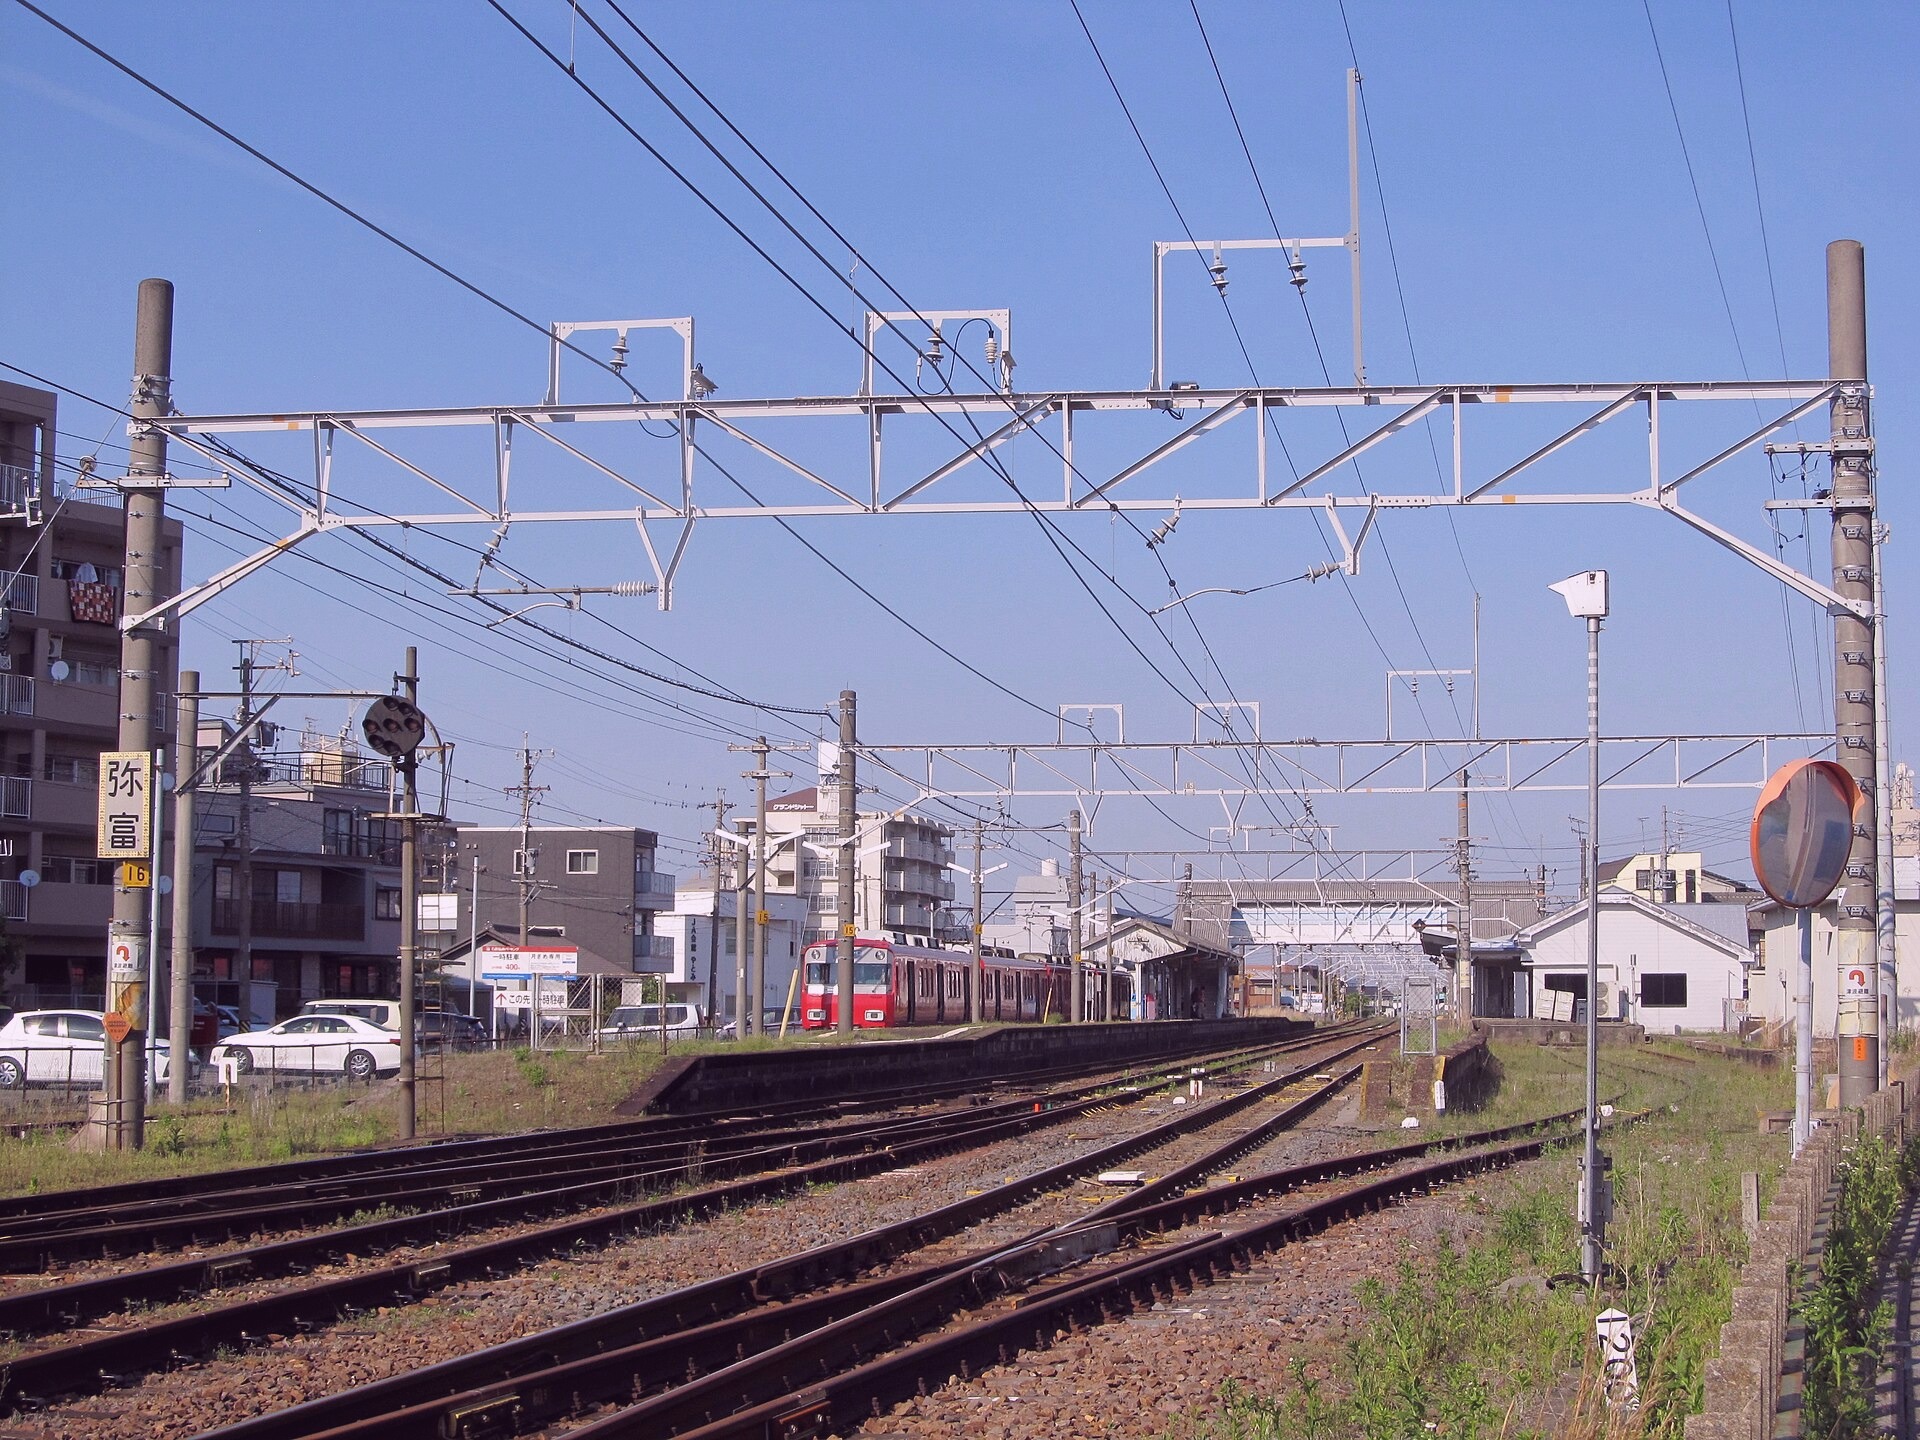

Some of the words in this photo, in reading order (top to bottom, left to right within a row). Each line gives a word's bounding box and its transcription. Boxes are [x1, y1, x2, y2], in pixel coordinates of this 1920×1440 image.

[108, 760, 143, 849] 弥富
[128, 866, 145, 882] 16
[759, 913, 768, 921] 15
[845, 926, 854, 935] 15
